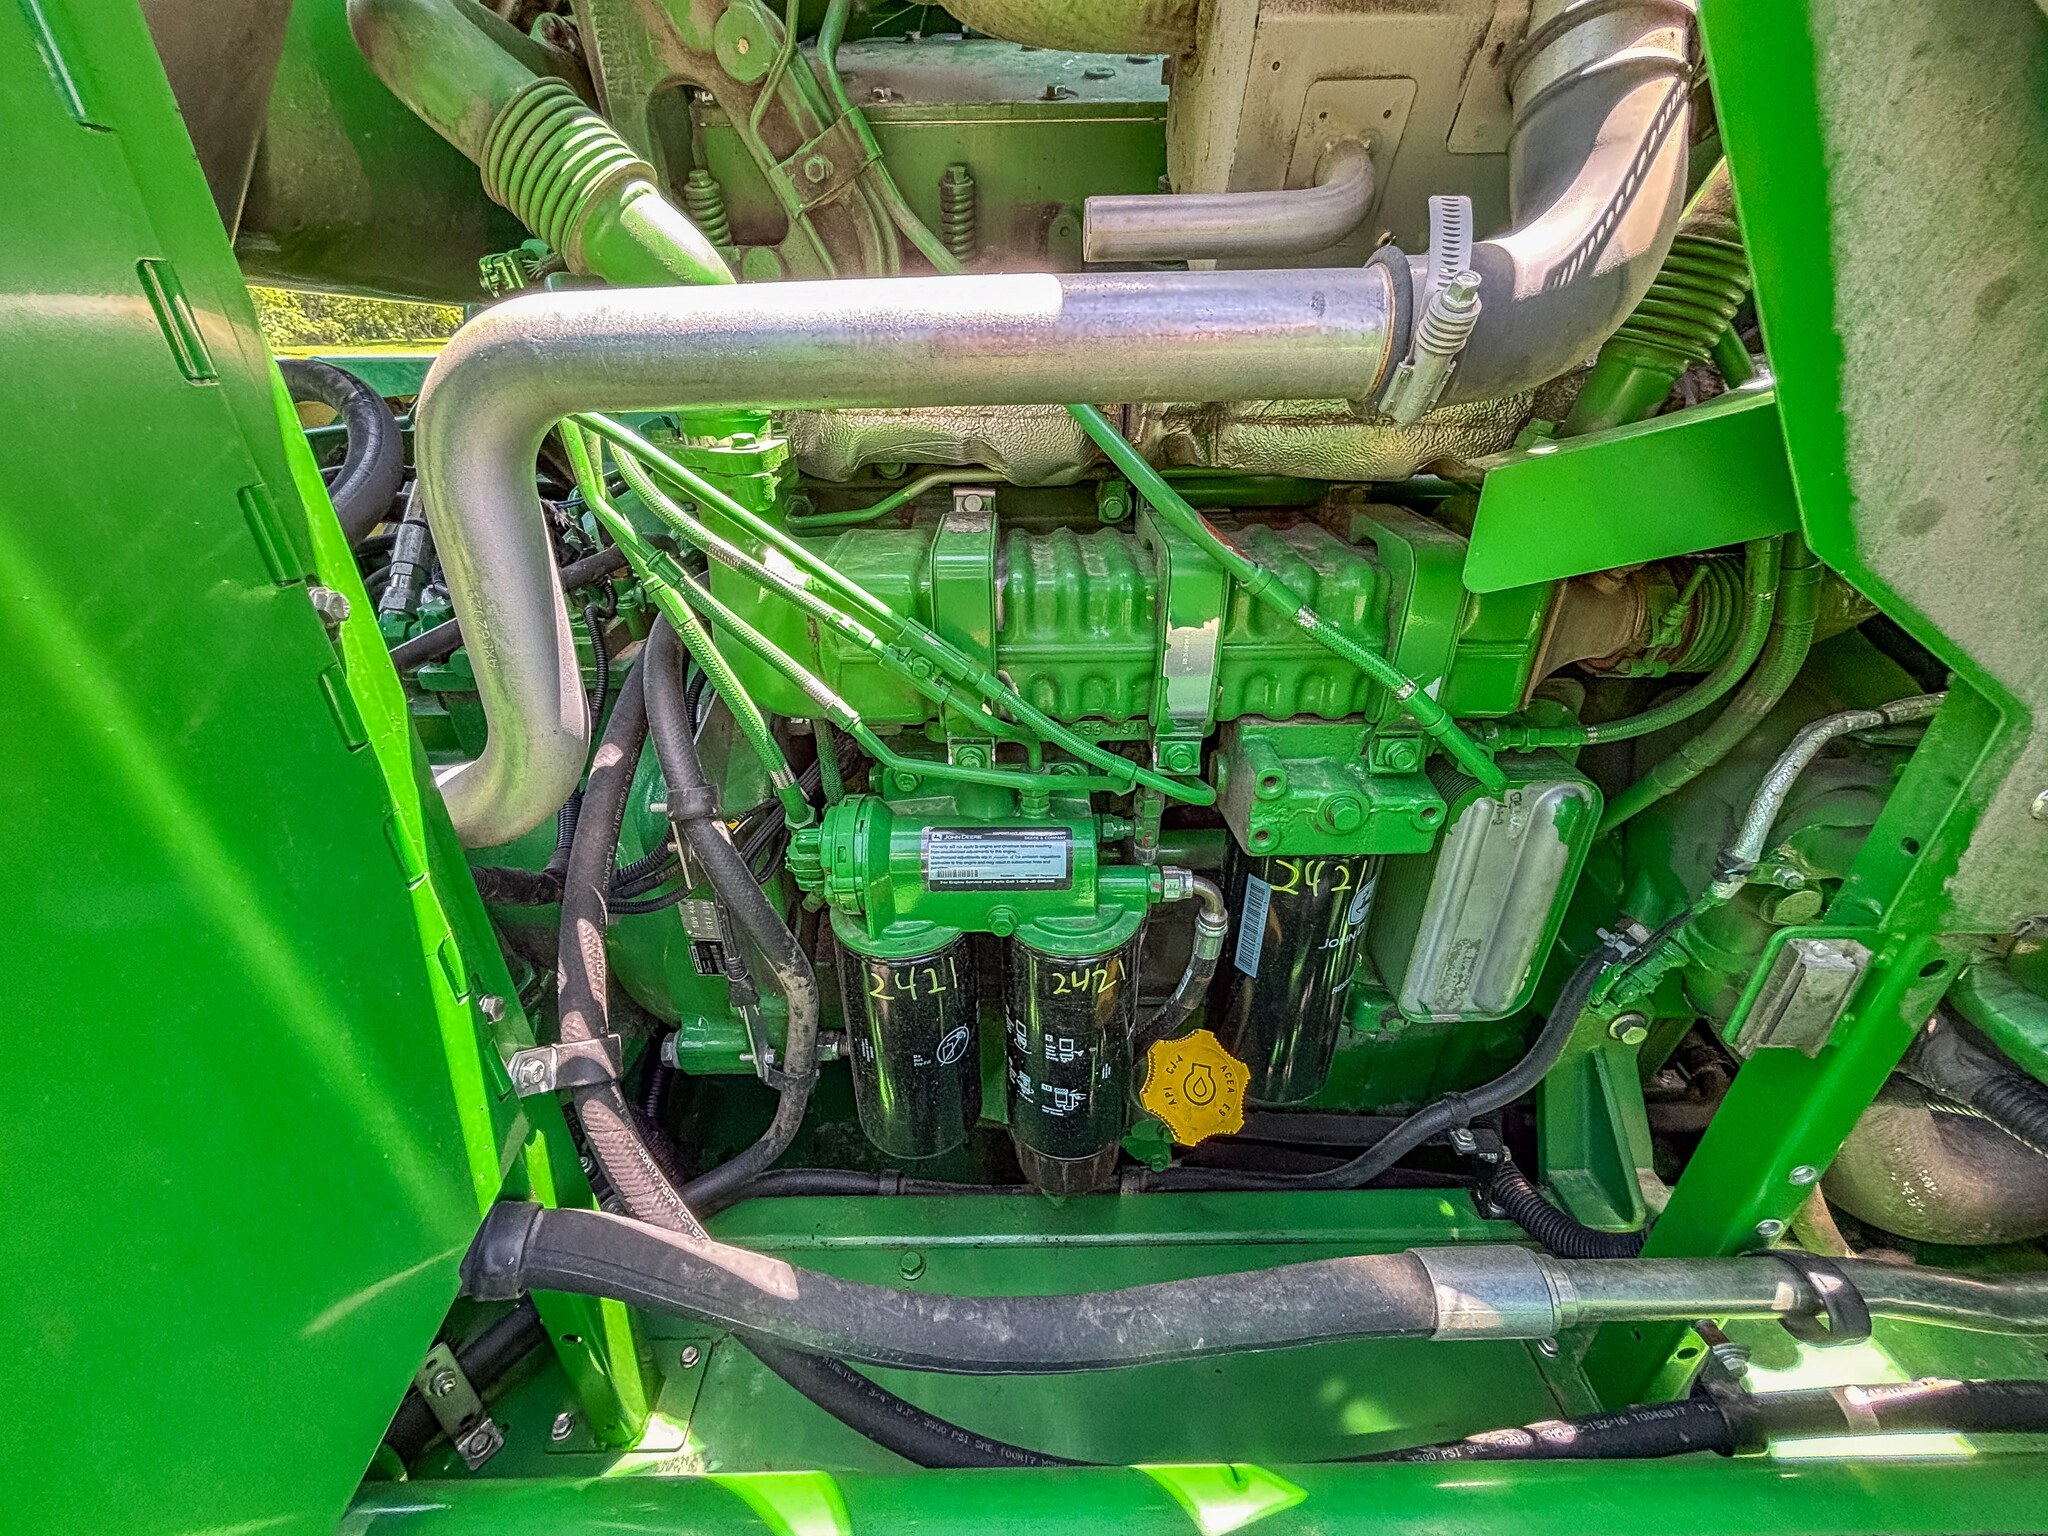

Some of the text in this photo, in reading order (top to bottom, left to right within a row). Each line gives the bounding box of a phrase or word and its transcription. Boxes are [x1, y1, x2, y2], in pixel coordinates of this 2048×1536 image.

[1318, 930, 1357, 950] JOHN
[1163, 1054, 1184, 1107] API CJ-4
[1220, 1064, 1236, 1094] ACEA
[1440, 1447, 1462, 1460] PSI
